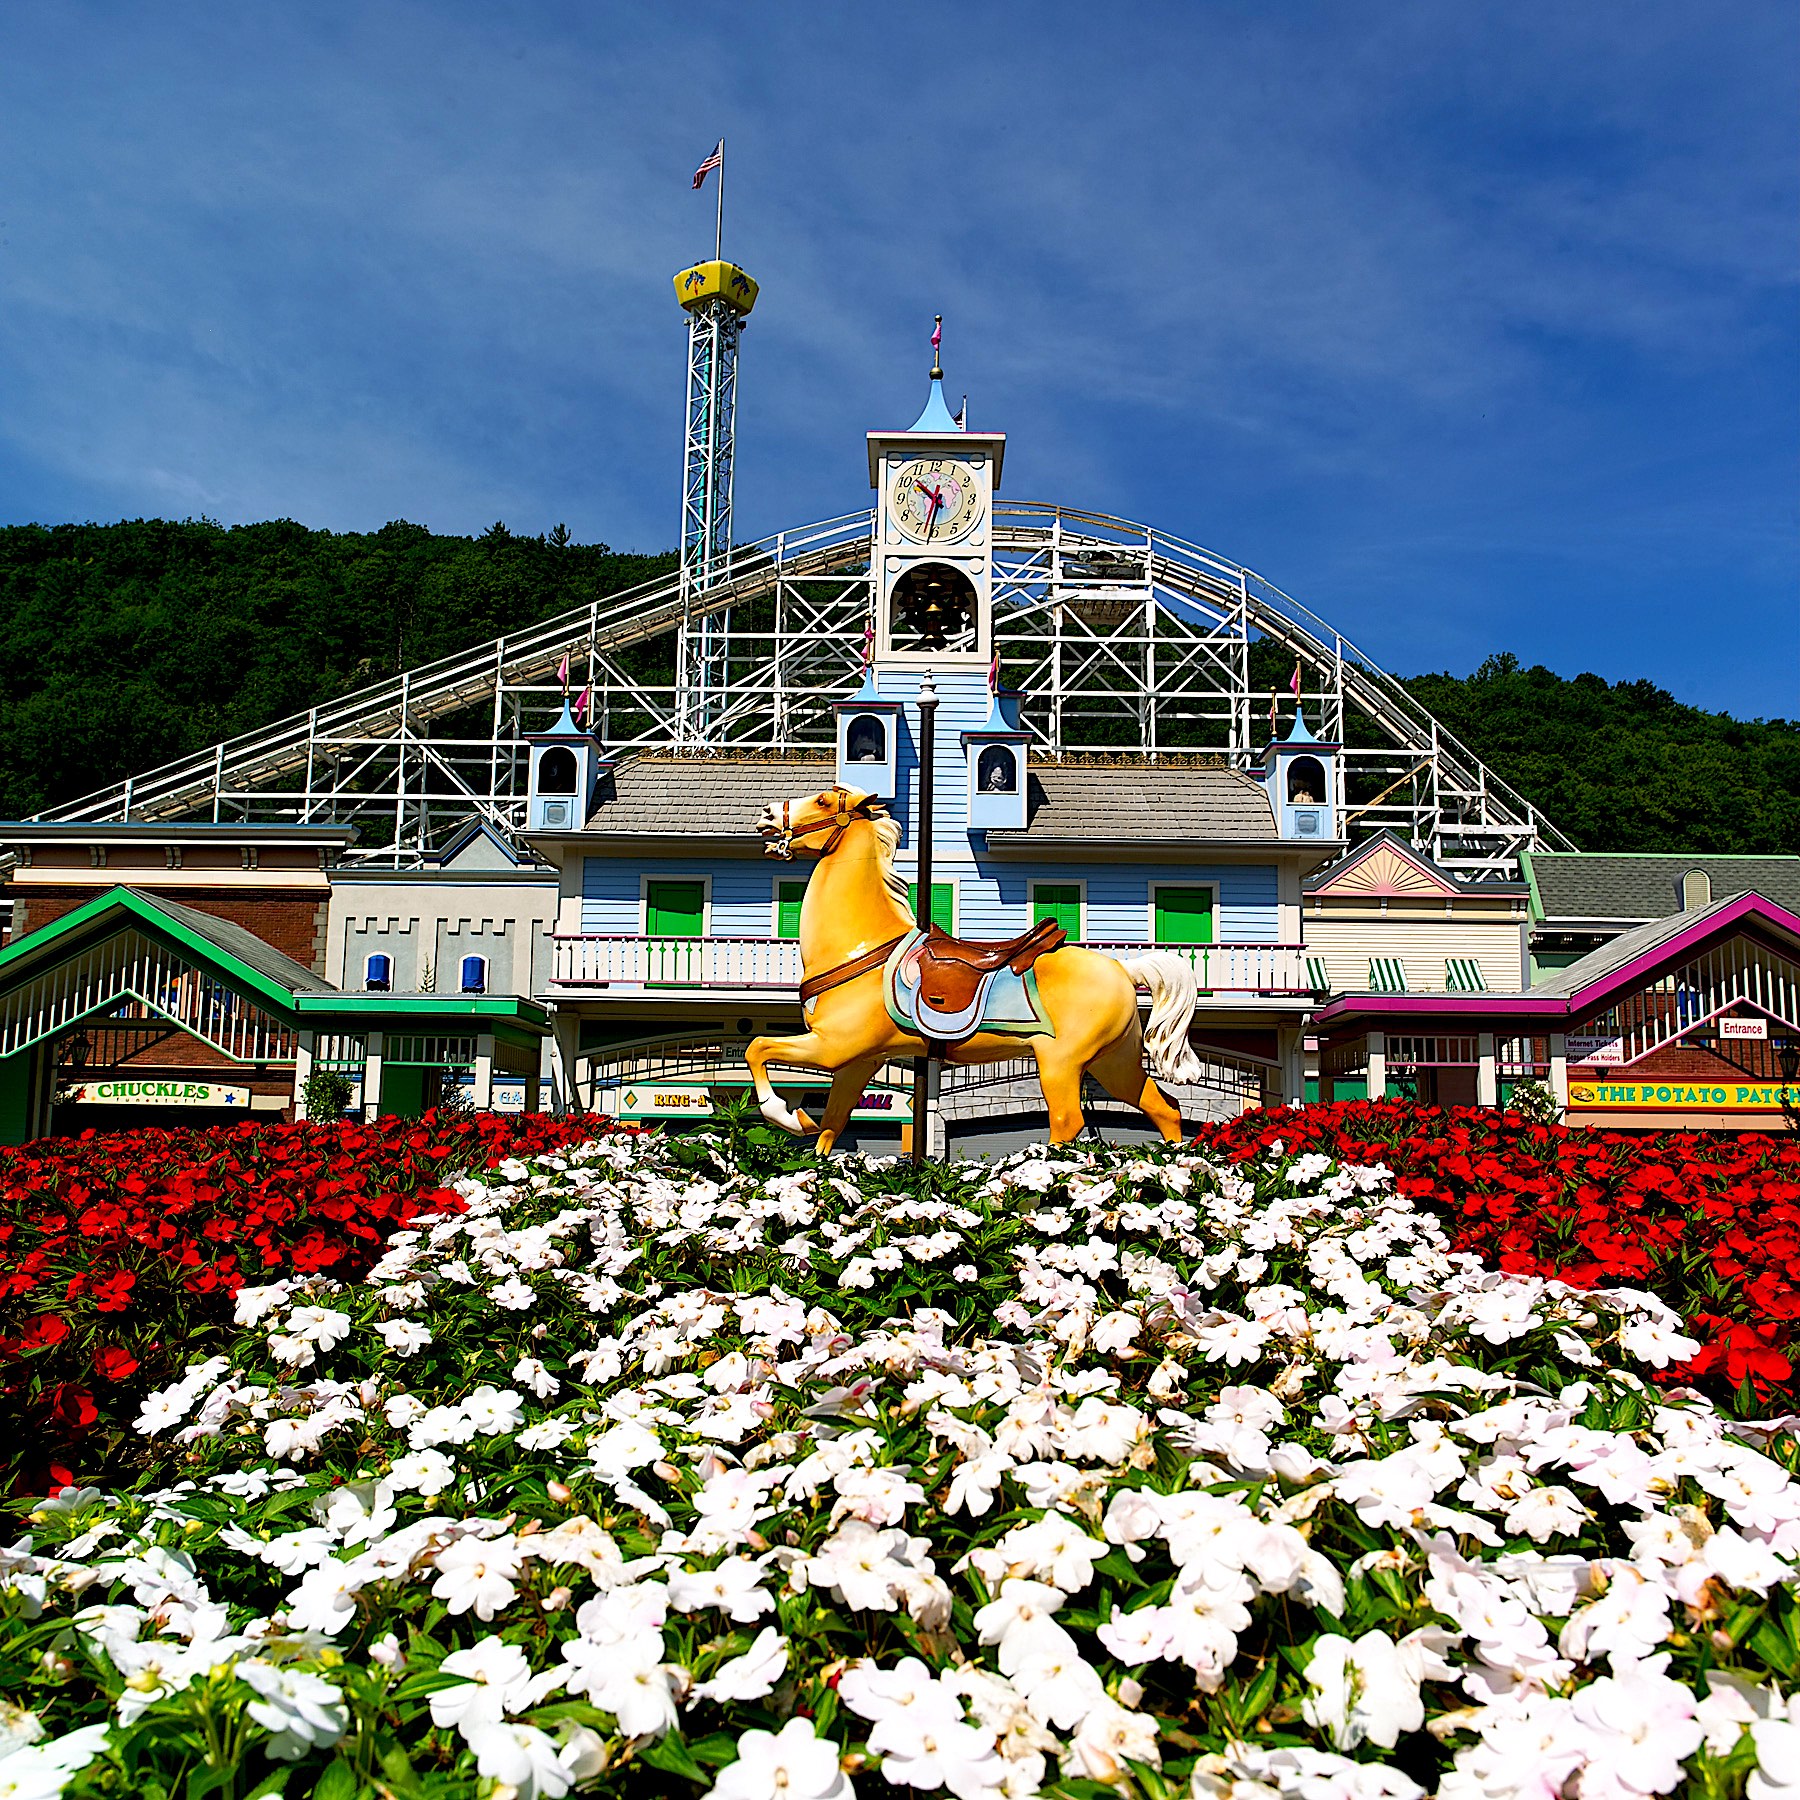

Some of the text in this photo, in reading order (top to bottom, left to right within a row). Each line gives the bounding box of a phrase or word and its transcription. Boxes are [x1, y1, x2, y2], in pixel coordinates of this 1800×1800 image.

[913, 464, 924, 475] 11
[930, 460, 943, 472] 12
[951, 465, 957, 475] 1
[899, 476, 912, 488] 10
[962, 476, 971, 488] 2
[896, 493, 906, 505] 9
[967, 493, 977, 506] 3
[900, 510, 910, 521] 8
[963, 509, 972, 521] 4
[914, 522, 924, 534] 7
[931, 526, 940, 538] 6
[949, 523, 959, 534] 5
[1723, 1022, 1763, 1034] Entrance
[1567, 1039, 1593, 1047] Internet
[725, 1046, 745, 1058] Entr
[97, 1082, 210, 1100] CHUCKLES
[1596, 1086, 1800, 1103] THE POTATO PATCH
